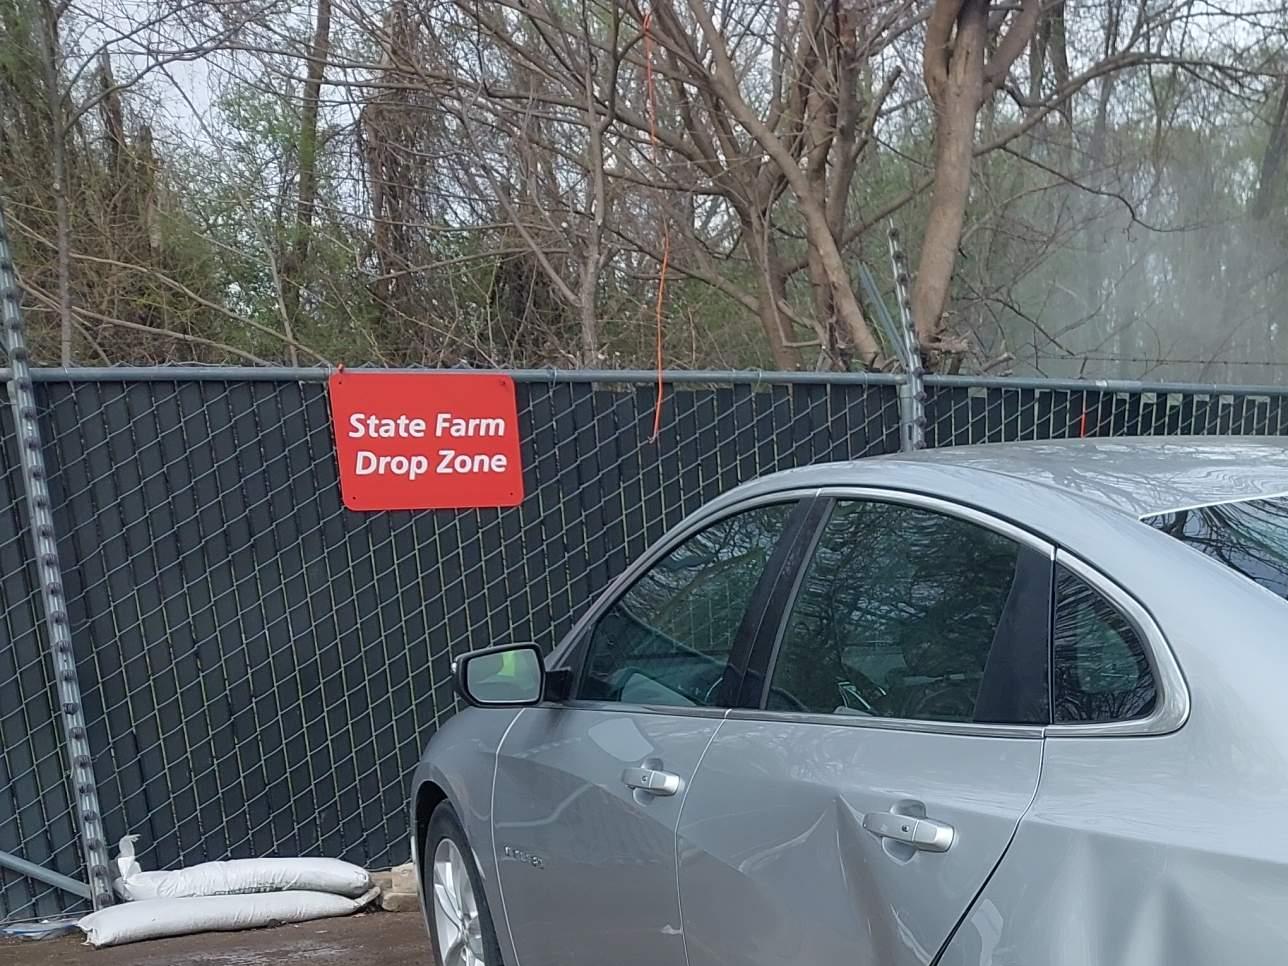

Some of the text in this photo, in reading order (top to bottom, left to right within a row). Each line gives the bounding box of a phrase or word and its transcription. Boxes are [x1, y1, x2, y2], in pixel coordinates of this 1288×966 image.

[349, 413, 505, 438] State Farm
[355, 450, 508, 481] Drop Zone
